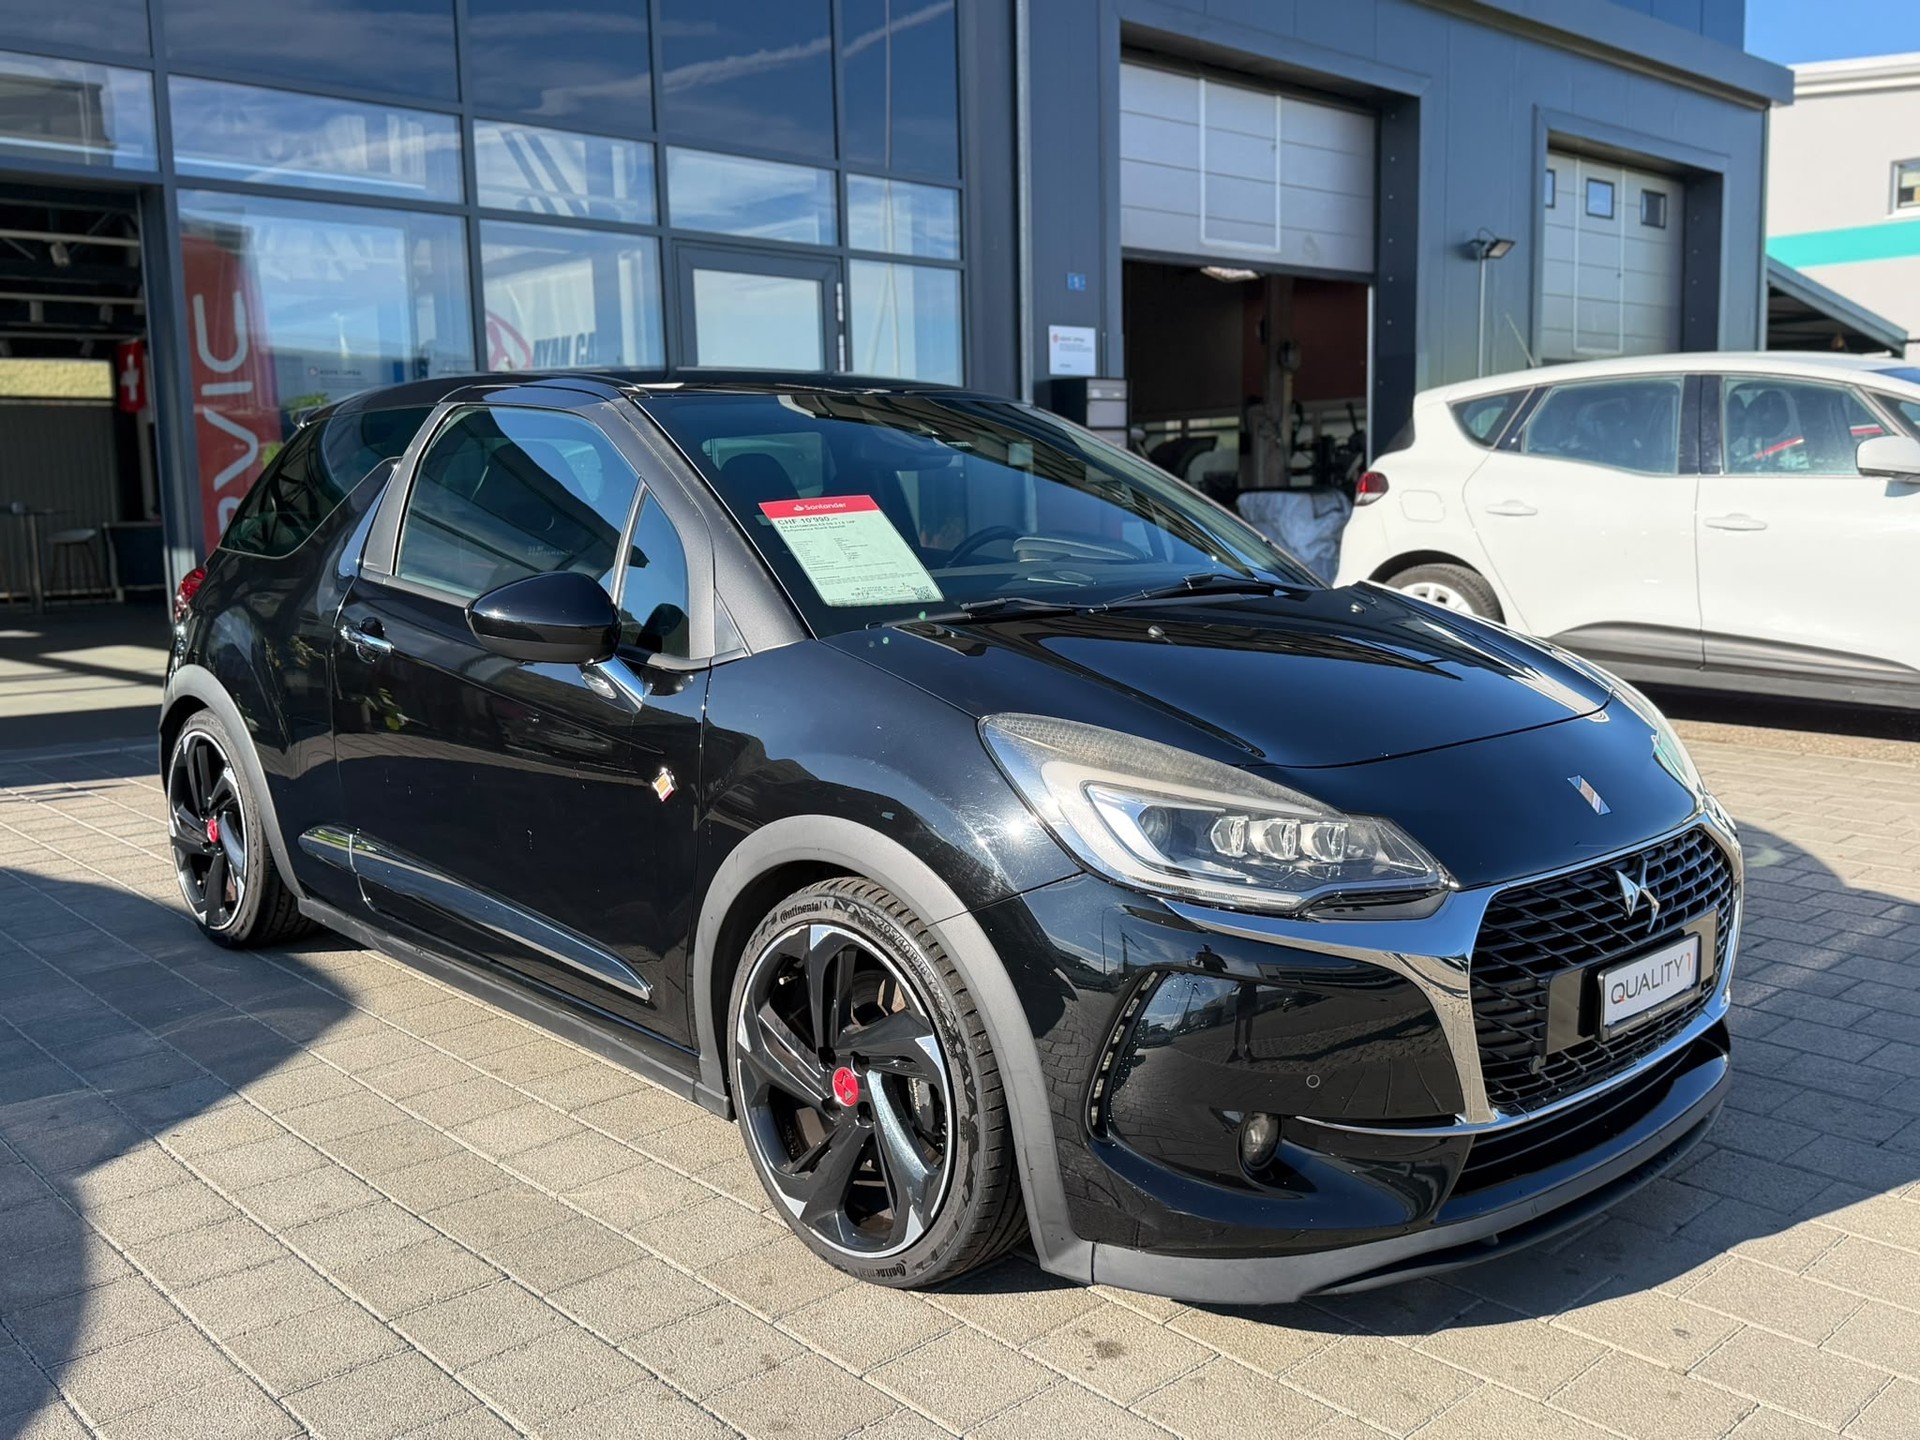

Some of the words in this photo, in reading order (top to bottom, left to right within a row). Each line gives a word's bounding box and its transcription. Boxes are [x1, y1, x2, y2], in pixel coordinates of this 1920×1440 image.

[804, 502, 846, 511] Santander
[777, 518, 797, 526] CHF
[780, 901, 822, 924] Continental
[858, 1262, 906, 1280] Continental
